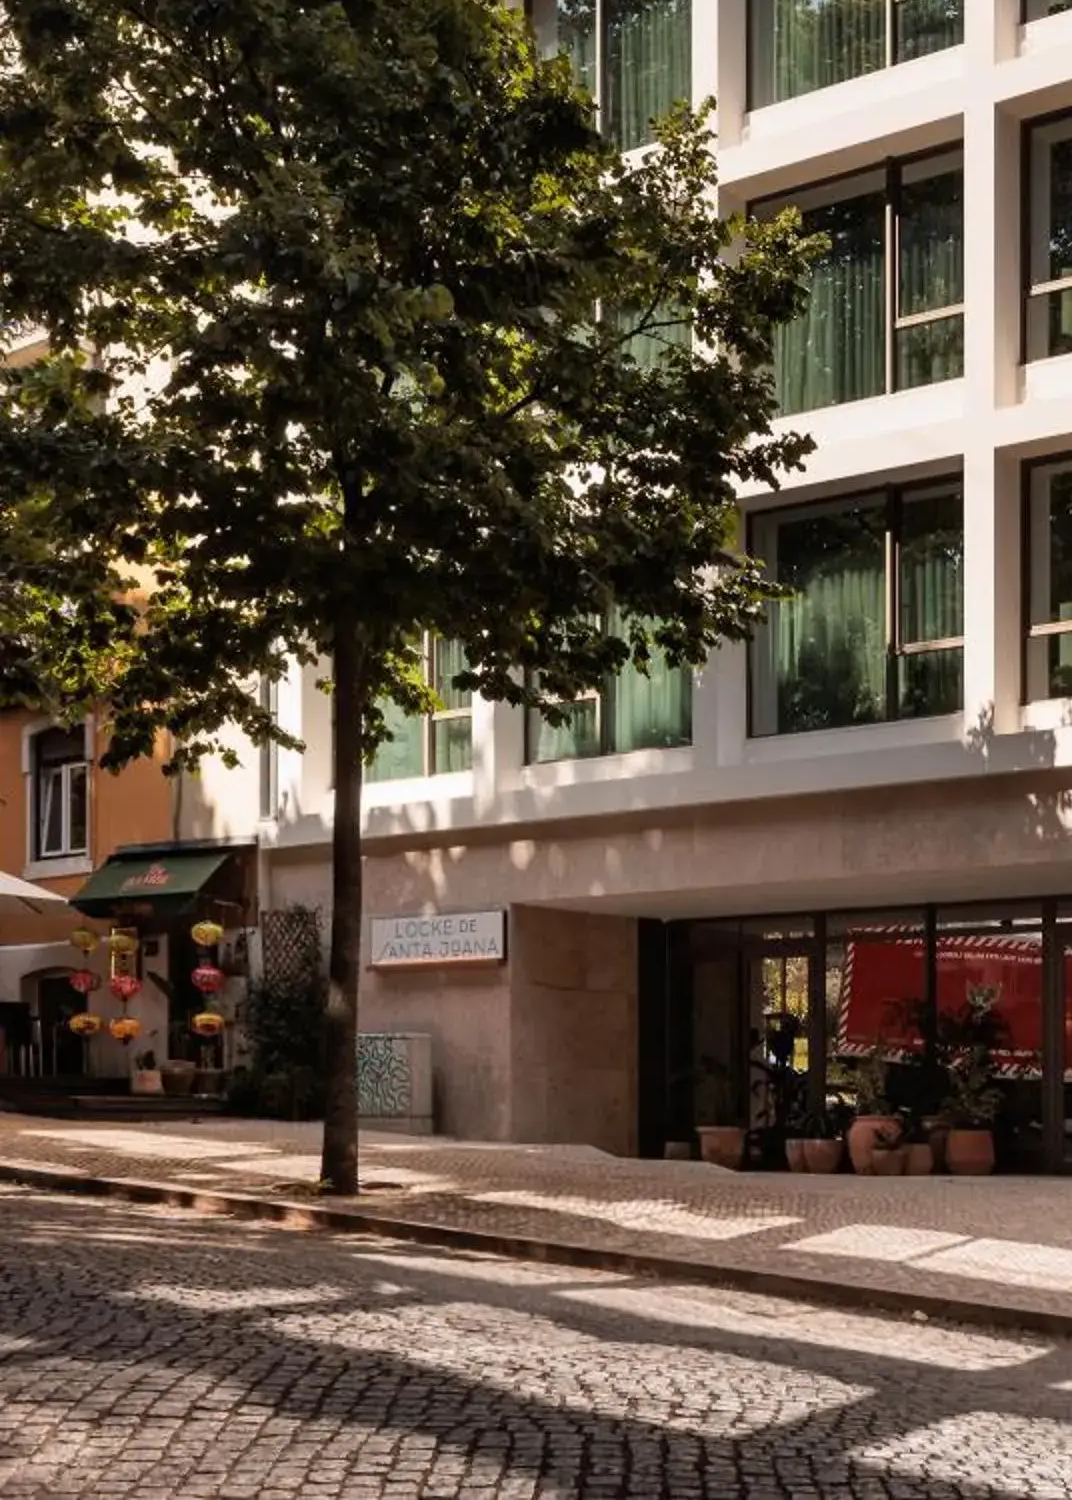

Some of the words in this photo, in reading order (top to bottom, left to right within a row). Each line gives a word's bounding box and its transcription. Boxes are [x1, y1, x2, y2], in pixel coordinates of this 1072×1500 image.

[394, 919, 452, 939] LOCKE
[459, 918, 478, 933] DE
[379, 941, 433, 960] SANTA
[440, 937, 499, 958] JOANA
